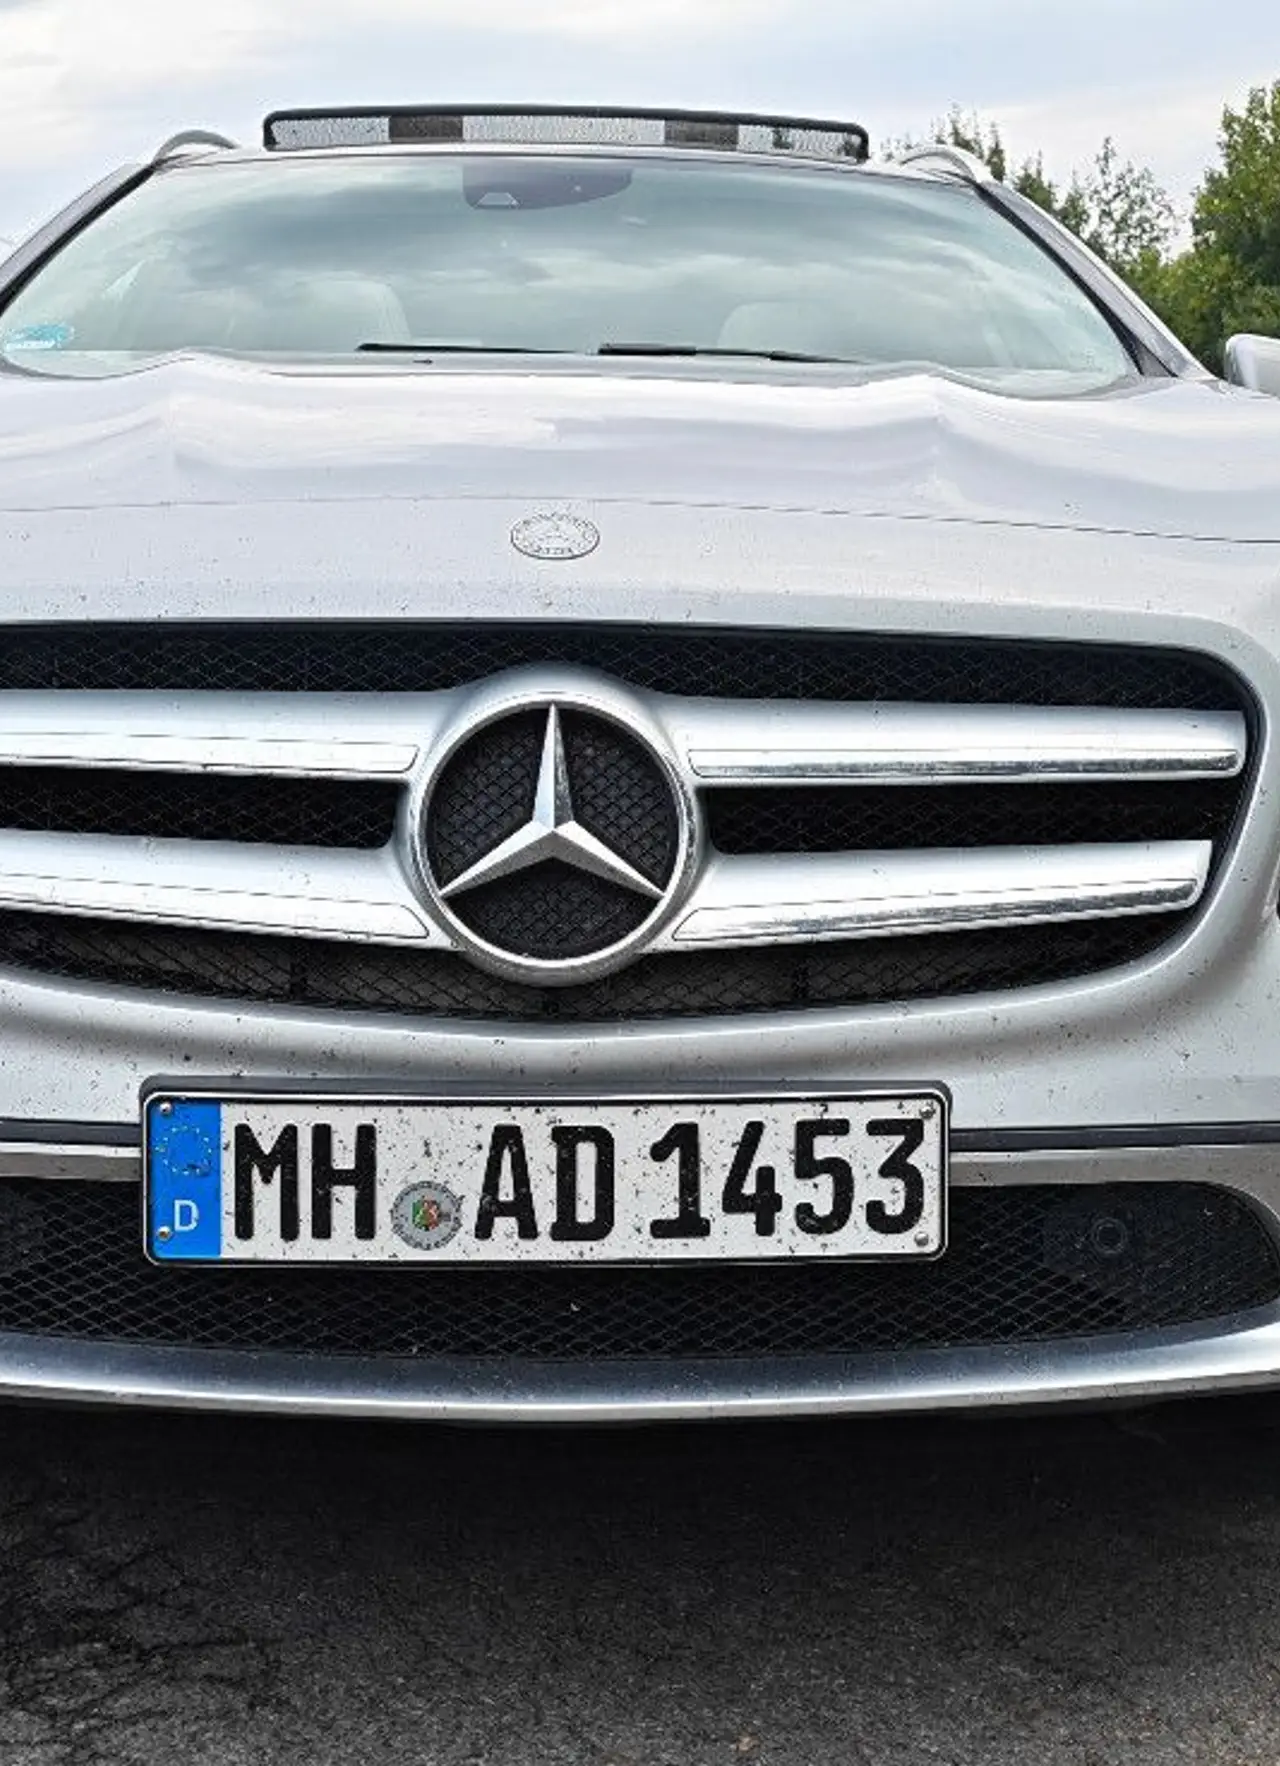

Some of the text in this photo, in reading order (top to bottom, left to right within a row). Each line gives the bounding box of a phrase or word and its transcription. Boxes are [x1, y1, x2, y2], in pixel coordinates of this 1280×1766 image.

[174, 1199, 200, 1232] D
[233, 1122, 378, 1241] MH
[474, 1124, 616, 1241] AD
[649, 1119, 926, 1238] 1453
